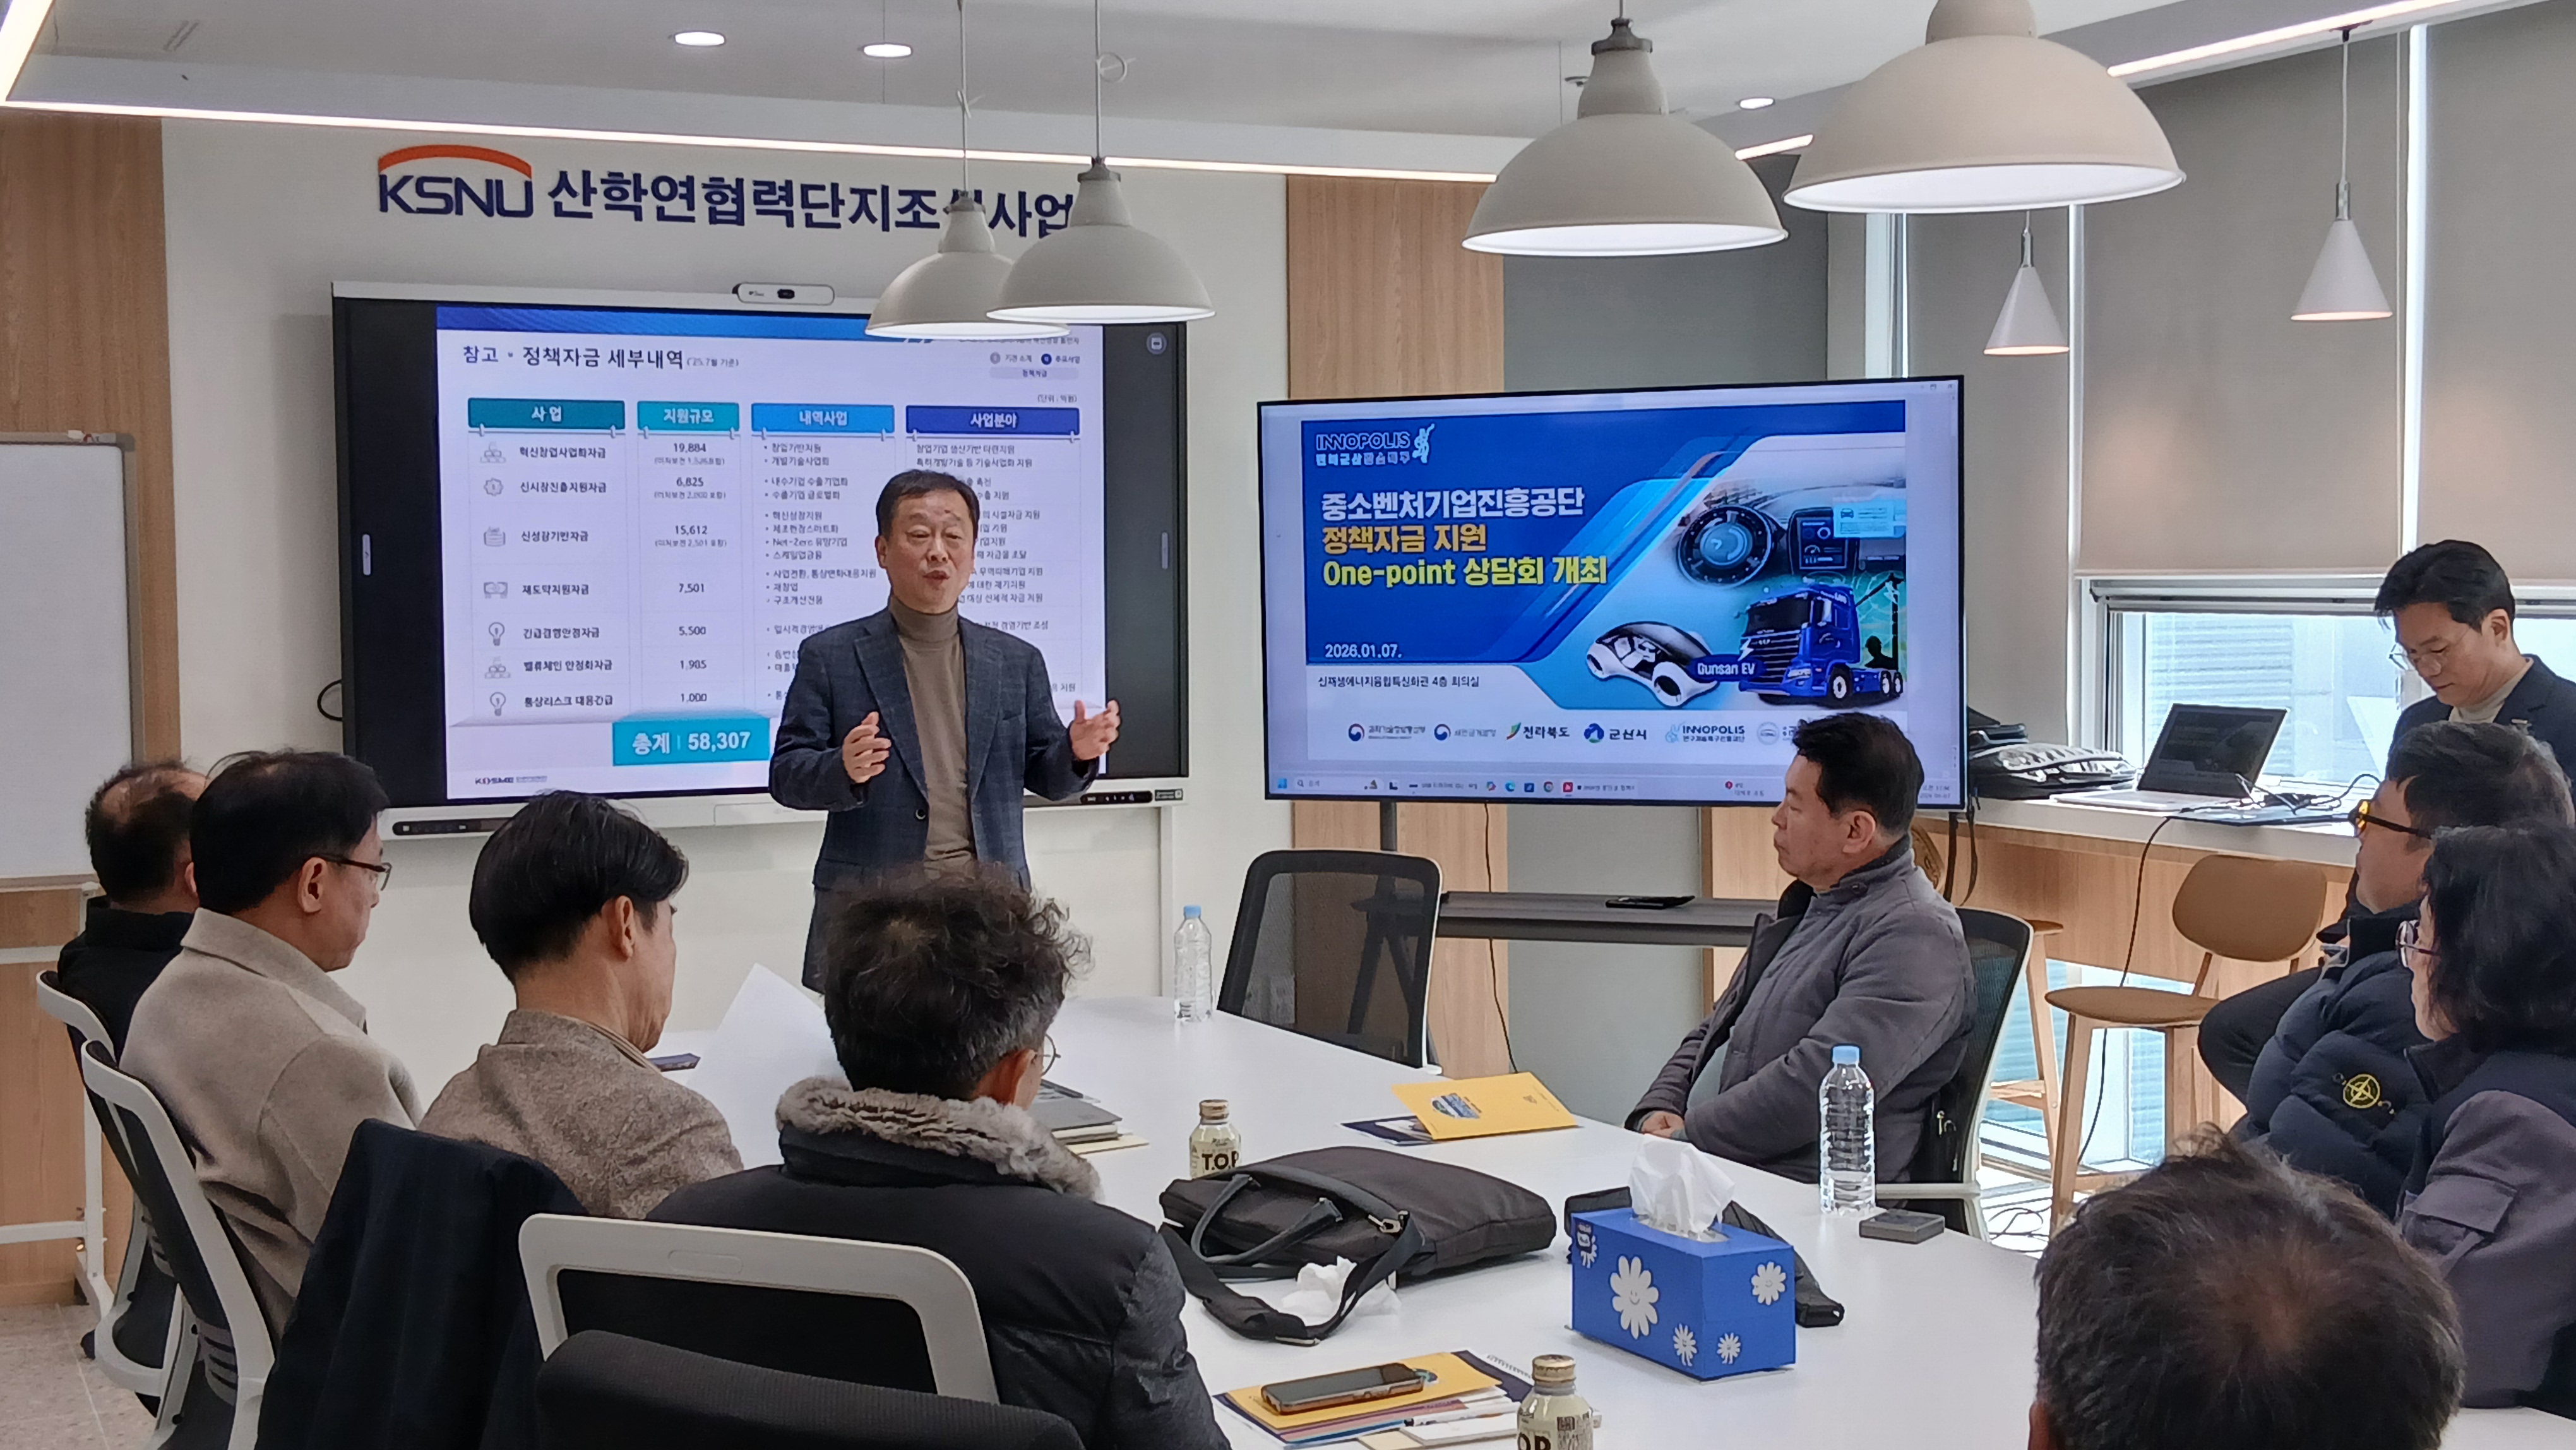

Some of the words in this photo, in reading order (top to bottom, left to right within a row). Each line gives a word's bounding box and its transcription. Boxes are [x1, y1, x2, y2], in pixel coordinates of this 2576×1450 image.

[379, 174, 534, 218] KSNU
[463, 346, 498, 363] 참고
[523, 347, 600, 367] 정책자금
[608, 349, 683, 369] 세부내역
[663, 408, 715, 424] 지원규모
[798, 410, 849, 427] 내역사업
[970, 412, 1018, 429] 사업분야
[1316, 431, 1410, 450] INNOPOLIS
[994, 491, 1009, 500] 지원
[1322, 487, 1585, 521] 중소벤처기업진흥공단
[1025, 510, 1040, 519] 지원
[676, 525, 707, 536] 15,612
[1322, 525, 1424, 554] 정책자금
[1434, 524, 1486, 551] 지원
[1029, 568, 1042, 576] 지원
[1323, 560, 1455, 587] One-point
[1463, 557, 1543, 585] 상담회
[1552, 555, 1607, 583] 개최
[679, 583, 704, 593] 7,501
[1028, 594, 1042, 602] 지원
[679, 626, 706, 636] 5,500
[1325, 644, 1402, 658] 2026.01.07.
[681, 660, 707, 669] 1,905
[1697, 662, 1739, 675] Gunsan
[1741, 662, 1755, 675] EV
[1451, 675, 1479, 688] 회의실
[681, 693, 707, 702] 1,000
[1522, 726, 1571, 740] 전라북도
[1609, 728, 1647, 741] 군산시
[1683, 724, 1745, 734] INNOPOLIS
[632, 732, 669, 754] 총계
[688, 731, 751, 752] 58,307
[1202, 1151, 1239, 1171] T.O.P
